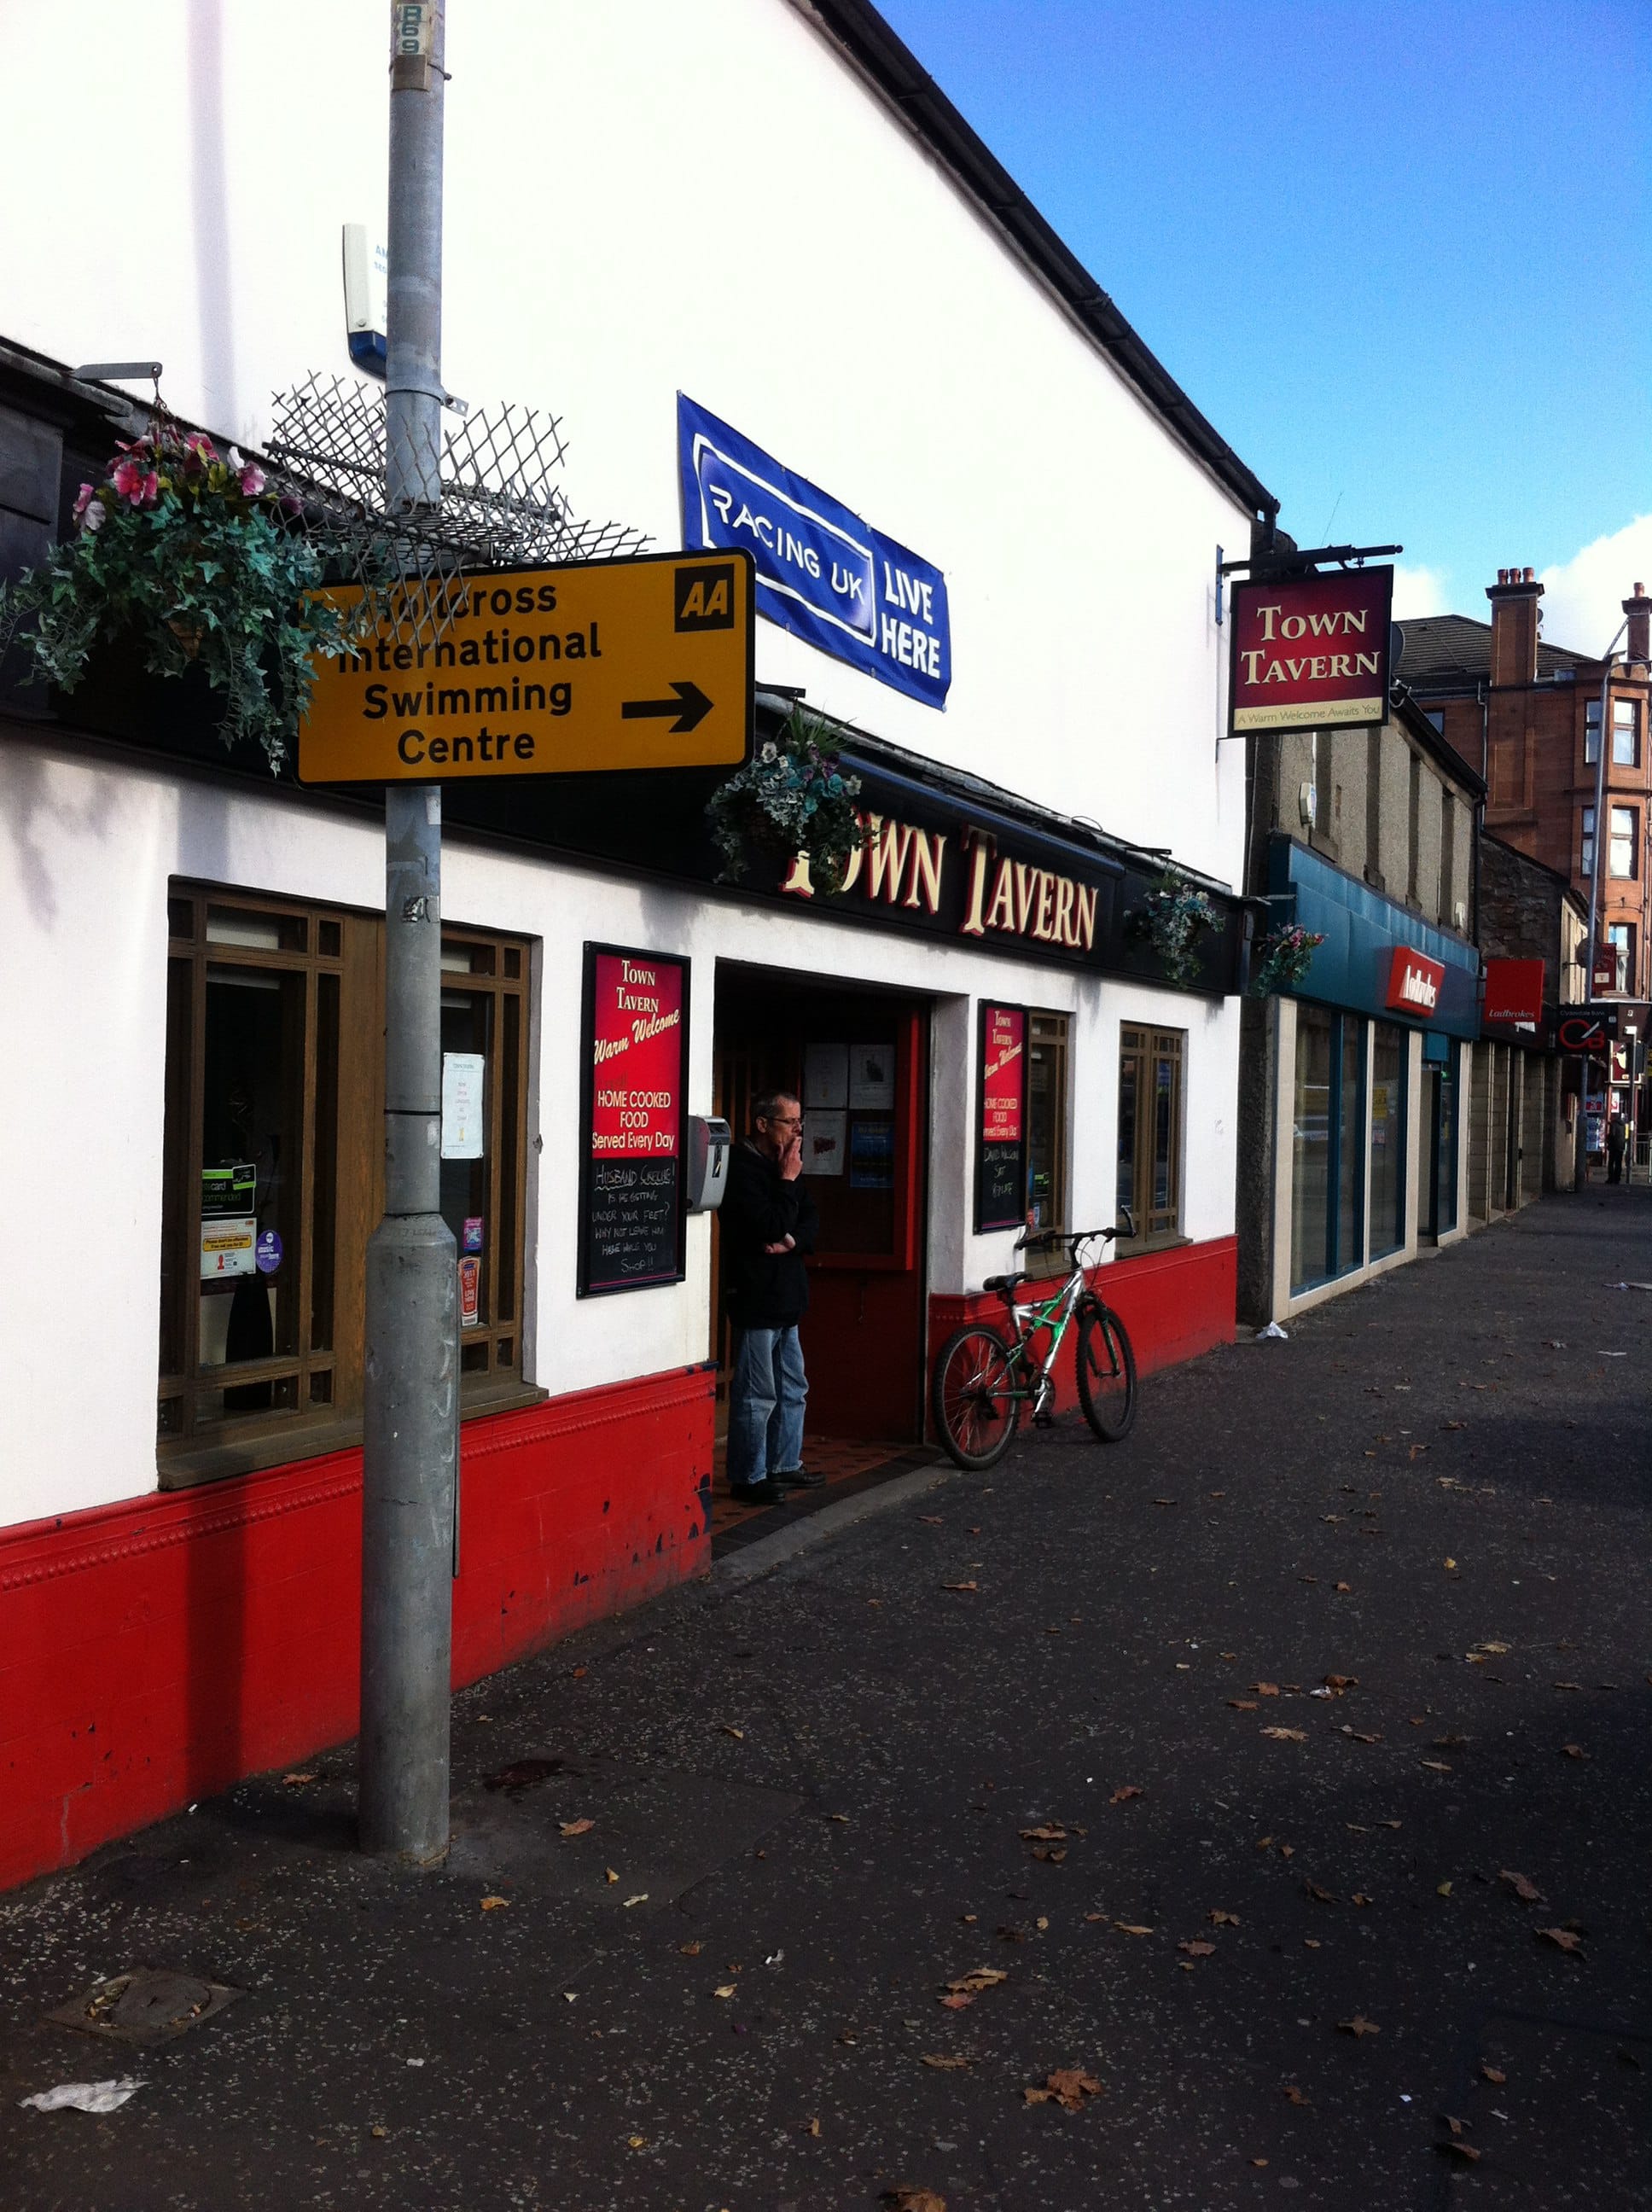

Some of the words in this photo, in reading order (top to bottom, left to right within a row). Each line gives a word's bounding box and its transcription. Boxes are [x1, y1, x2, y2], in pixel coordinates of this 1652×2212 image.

[709, 484, 820, 579] RACING
[831, 562, 865, 606] UK
[680, 580, 728, 619] AA
[883, 560, 934, 626] LIVE
[1257, 605, 1369, 641] TOWN
[339, 622, 602, 673] International
[881, 613, 940, 679] HERE
[1241, 649, 1381, 685] TAVERN
[363, 677, 573, 720] Swimming
[1238, 715, 1246, 724] A
[1249, 714, 1277, 724] Warm
[1280, 709, 1325, 721] Welcome
[1328, 707, 1359, 718] Awaits
[1362, 704, 1380, 715] You
[398, 727, 535, 765] Centre
[958, 822, 1099, 951] TAVERN
[621, 959, 655, 987] TOWN
[616, 987, 659, 1013] TAVERN
[1489, 1009, 1534, 1018] Ladbrokes
[594, 1036, 630, 1065] Warm
[631, 1009, 680, 1044] Welcome
[598, 1091, 627, 1108] HOME
[630, 1091, 672, 1108] COOKED
[620, 1111, 649, 1128] FOOD
[592, 1132, 625, 1149] Served
[627, 1132, 653, 1150] Every
[655, 1132, 674, 1150] Day
[596, 1163, 637, 1185] HUSBAND
[592, 1210, 617, 1223] UNDER
